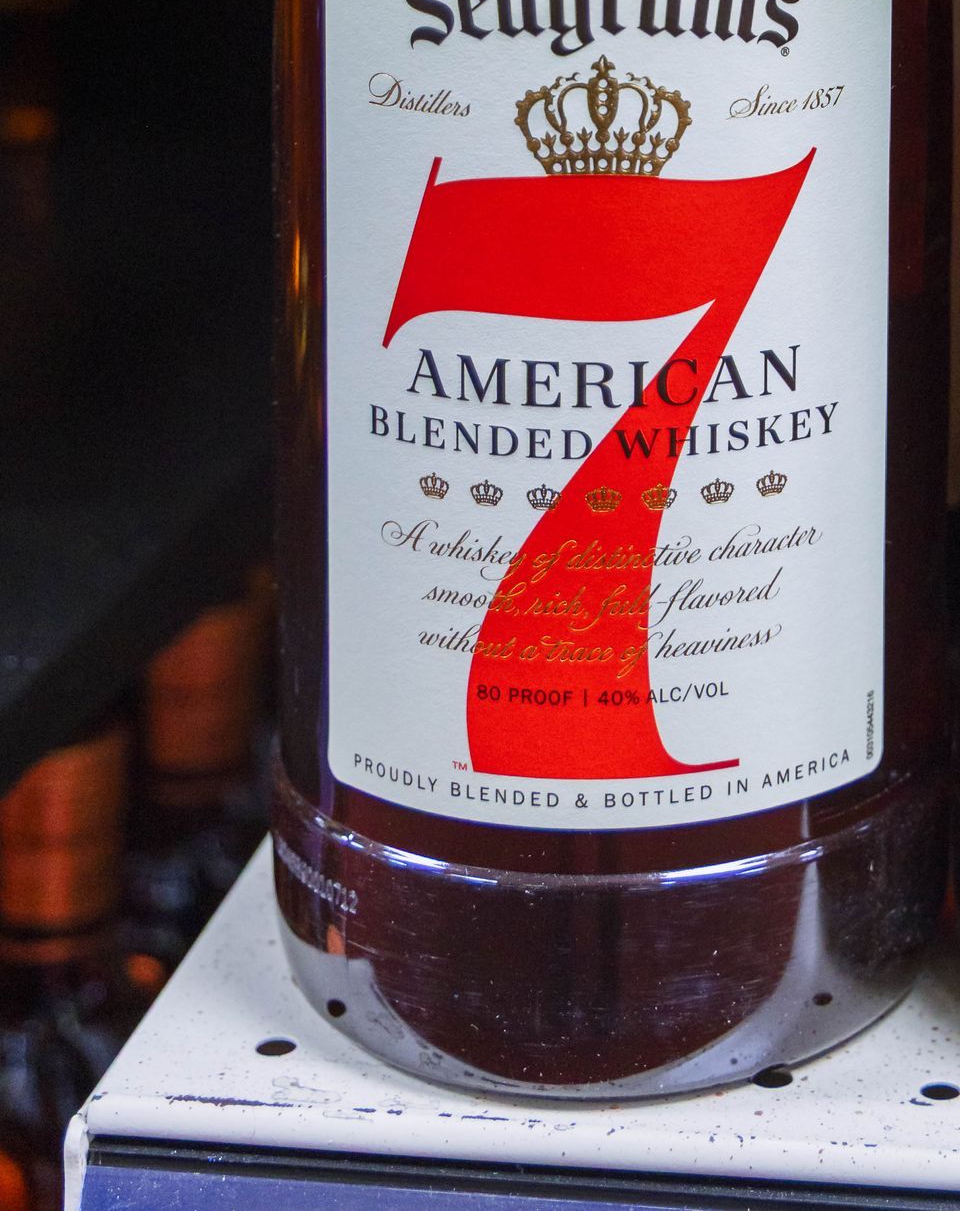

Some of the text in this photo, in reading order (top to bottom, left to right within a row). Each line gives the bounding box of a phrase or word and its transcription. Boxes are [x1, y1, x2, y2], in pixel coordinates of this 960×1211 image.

[368, 72, 845, 120] Distillers Since 1857
[406, 344, 801, 409] AMERICAN
[369, 401, 840, 460] BLENDED WHISKEY
[382, 147, 817, 780] 7
[380, 519, 824, 583] A whiskey of distinctive character
[421, 581, 527, 617] smooth,
[567, 567, 784, 632] full-flavored
[417, 624, 517, 660] without
[519, 644, 540, 661] a
[616, 631, 664, 679] of
[654, 623, 783, 660] heaviness
[476, 684, 501, 702] 80
[508, 688, 574, 706] PROOF
[597, 689, 640, 707] 40%
[646, 681, 729, 704] ALC/VOL
[353, 748, 851, 809] PROUDLY BLENDED & BOTTLED IN AMERICA
